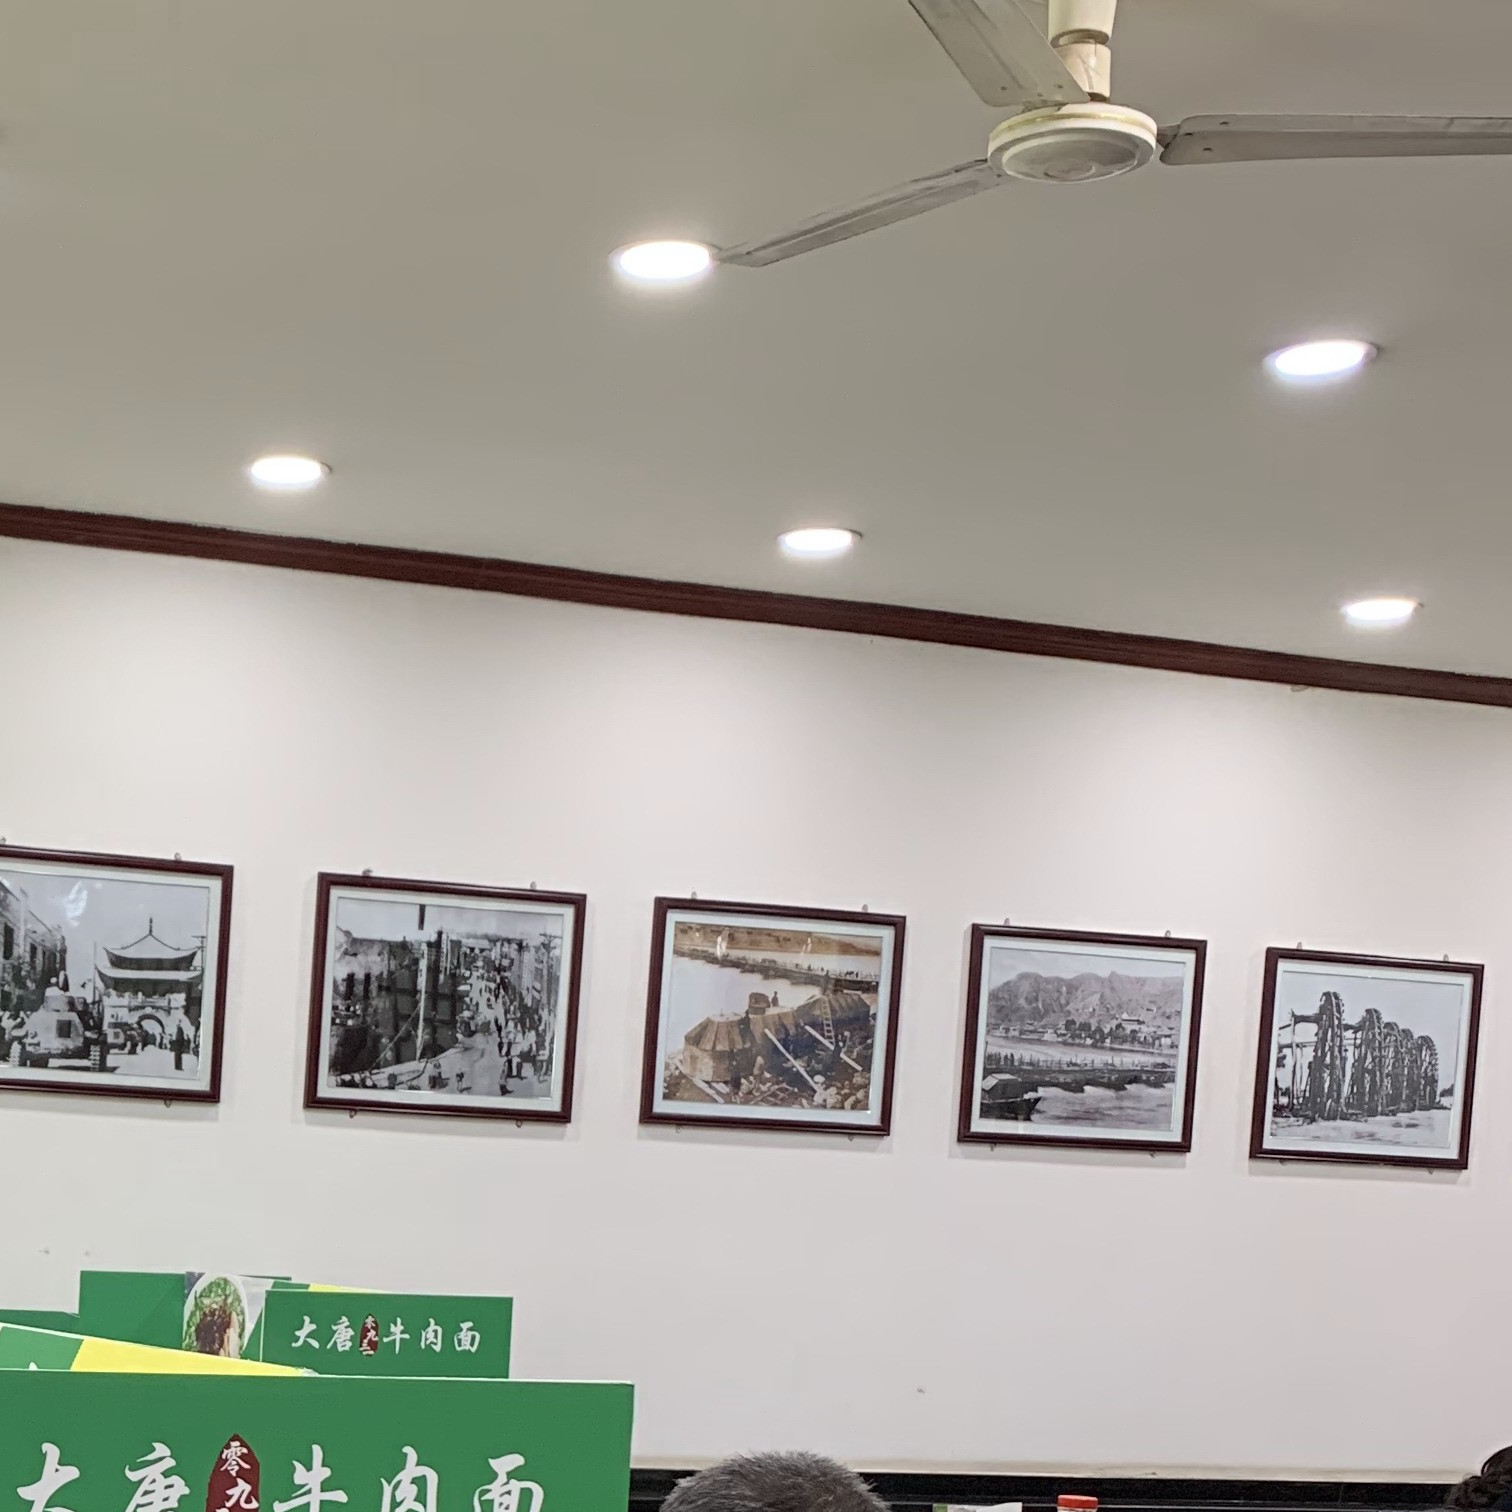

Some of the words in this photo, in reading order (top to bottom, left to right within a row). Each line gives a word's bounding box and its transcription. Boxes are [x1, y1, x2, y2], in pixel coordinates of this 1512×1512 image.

[291, 1315, 355, 1353] 大唐
[382, 1317, 482, 1354] 牛肉面
